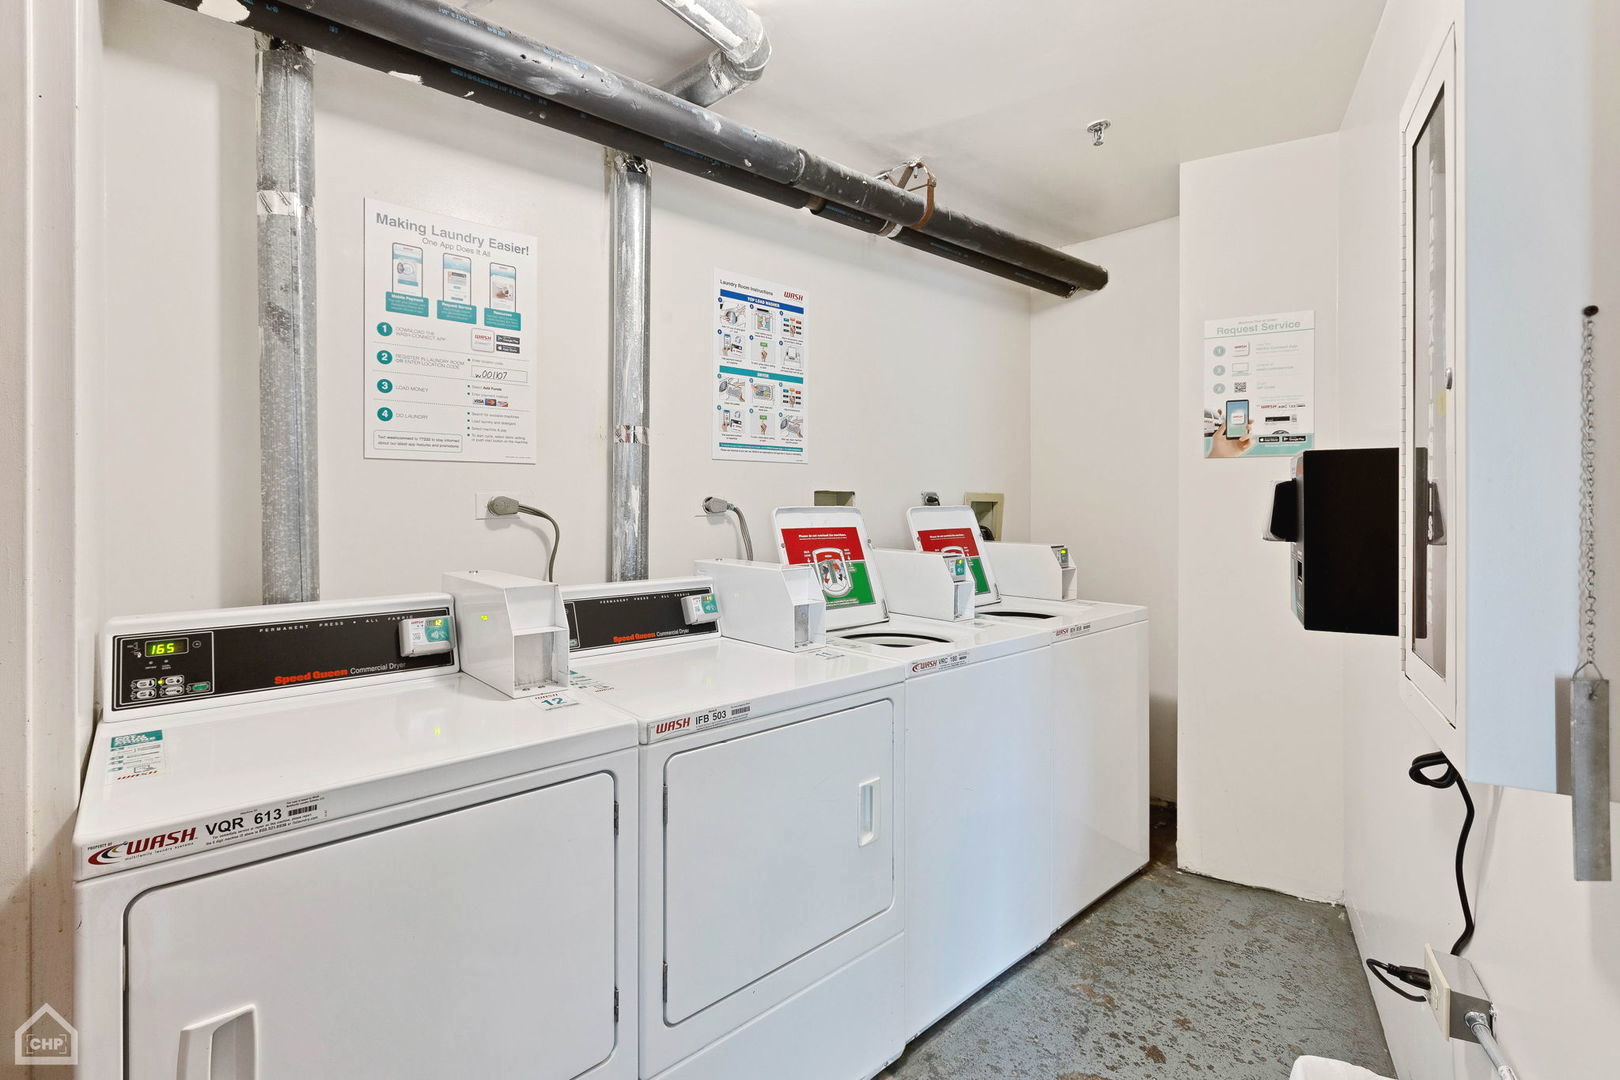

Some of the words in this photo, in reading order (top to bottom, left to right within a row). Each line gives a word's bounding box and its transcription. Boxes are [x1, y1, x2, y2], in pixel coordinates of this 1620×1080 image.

[376, 212, 427, 235] Making
[432, 225, 484, 248] Laundry
[489, 238, 530, 256] Easier!
[422, 238, 437, 246] One
[440, 242, 454, 251] App
[456, 244, 474, 254] Does
[482, 249, 490, 257] All
[720, 280, 738, 288] Laundry
[750, 286, 773, 296] Instructions
[784, 291, 804, 301] WASH
[1216, 324, 1258, 336] Request
[1262, 321, 1300, 331] Service
[259, 624, 309, 633] PERMANENT
[151, 642, 174, 655] 165
[920, 660, 937, 669] WASH
[274, 673, 311, 685] Speed
[312, 668, 348, 680] Queen
[350, 664, 388, 675] Commercial
[389, 662, 406, 670] Dryer
[541, 697, 567, 706] 12
[656, 717, 691, 734] WASH
[695, 714, 709, 725] IFB
[712, 710, 727, 720] 503
[205, 817, 244, 835] VQR
[254, 808, 282, 824] 613
[126, 827, 196, 855] WASH
[125, 852, 152, 860] multifamily
